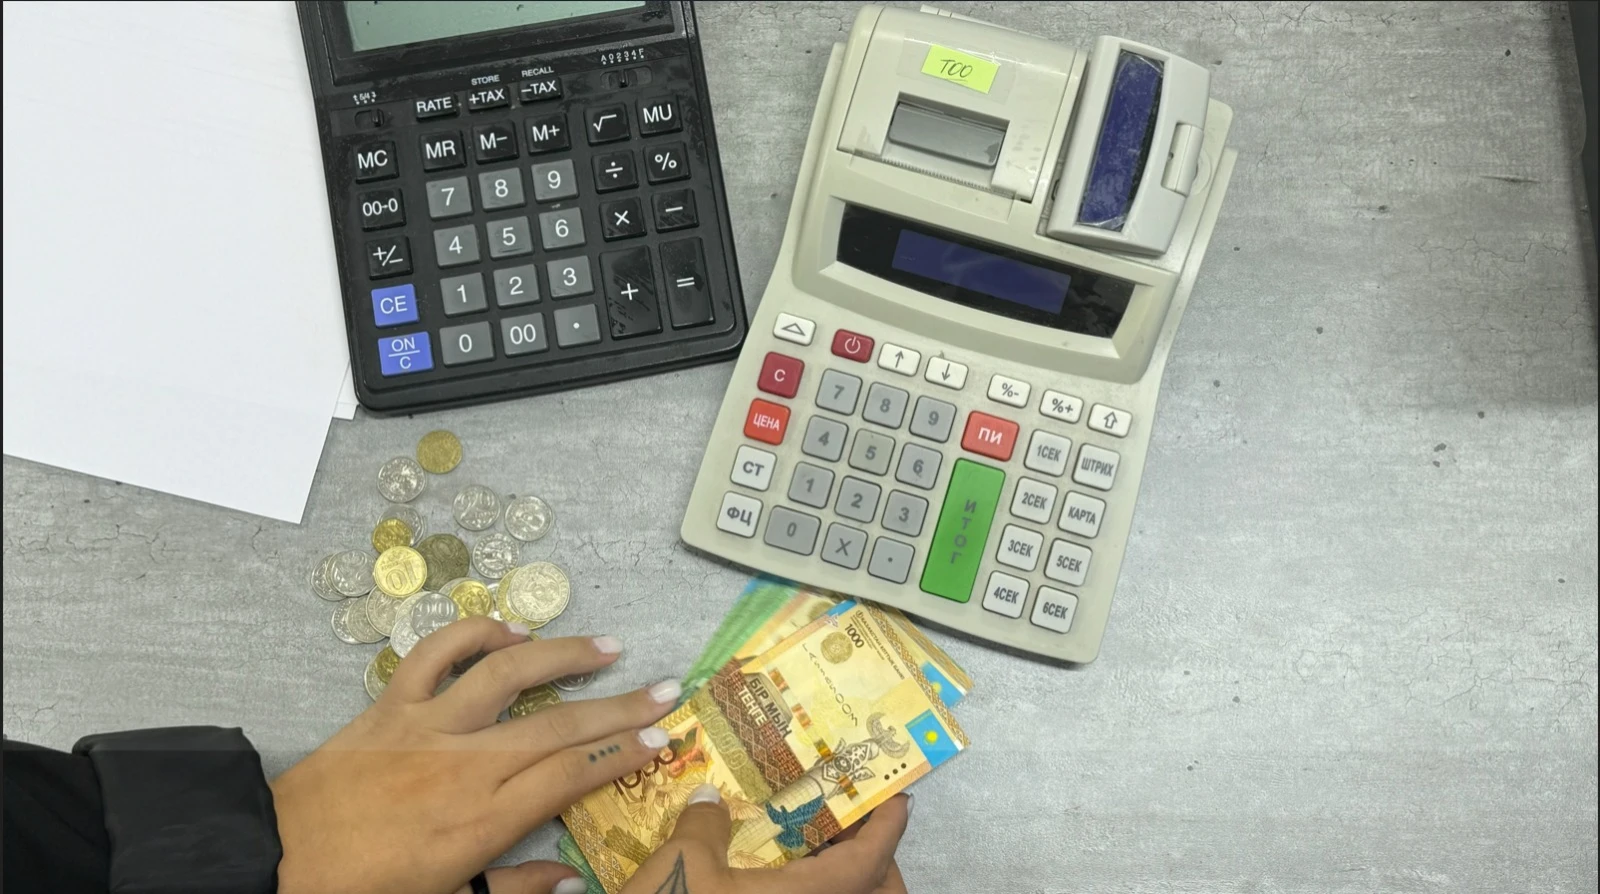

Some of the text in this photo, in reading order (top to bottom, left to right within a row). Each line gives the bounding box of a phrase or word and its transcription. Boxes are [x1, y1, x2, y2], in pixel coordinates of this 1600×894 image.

[471, 74, 500, 86] STORE
[521, 66, 555, 77] RECALL
[416, 96, 453, 113] RATE
[469, 88, 505, 105] +TAX
[643, 104, 673, 124] MU
[532, 124, 560, 143] M+
[357, 149, 389, 170] MC
[425, 139, 457, 160] MR
[494, 178, 509, 198] 8
[547, 170, 562, 189] 9
[441, 187, 455, 207] 7
[502, 226, 516, 246] 5
[554, 218, 569, 238] 6
[449, 235, 463, 255] 4
[508, 276, 524, 296] 2
[562, 267, 577, 287] 3
[456, 284, 467, 303] 1
[379, 294, 408, 315] CE
[391, 336, 416, 353] ON
[458, 332, 473, 353] 0
[509, 323, 537, 346] 00
[399, 355, 412, 370] C
[833, 384, 845, 401] 7
[879, 398, 891, 413] 8
[1052, 398, 1074, 414] %+
[752, 412, 781, 432] ЦЕНА
[928, 410, 940, 427] 9
[818, 431, 830, 447] 4
[977, 426, 1003, 446] ПИ
[865, 445, 877, 461] 5
[1036, 443, 1062, 463] 1СЕК
[912, 458, 924, 475] 6
[1081, 456, 1114, 478] ШТРИХ
[805, 477, 815, 494] 1
[850, 492, 863, 509] 2
[1021, 491, 1049, 511] 2СЕК
[726, 504, 753, 527] ФЦ
[898, 506, 910, 523] 3
[1067, 505, 1097, 525] КАРТА
[786, 521, 798, 538] 0
[950, 498, 977, 565] ИТОГ
[1007, 538, 1034, 559] 3СЕК
[1055, 554, 1083, 574] 5СЕК
[993, 585, 1020, 605] 4СЕК
[1042, 601, 1069, 621] 6СЕК
[844, 623, 865, 649] 1000
[738, 684, 768, 727] ТЕҢГЕ
[749, 677, 793, 740] БІР МЫҢ
